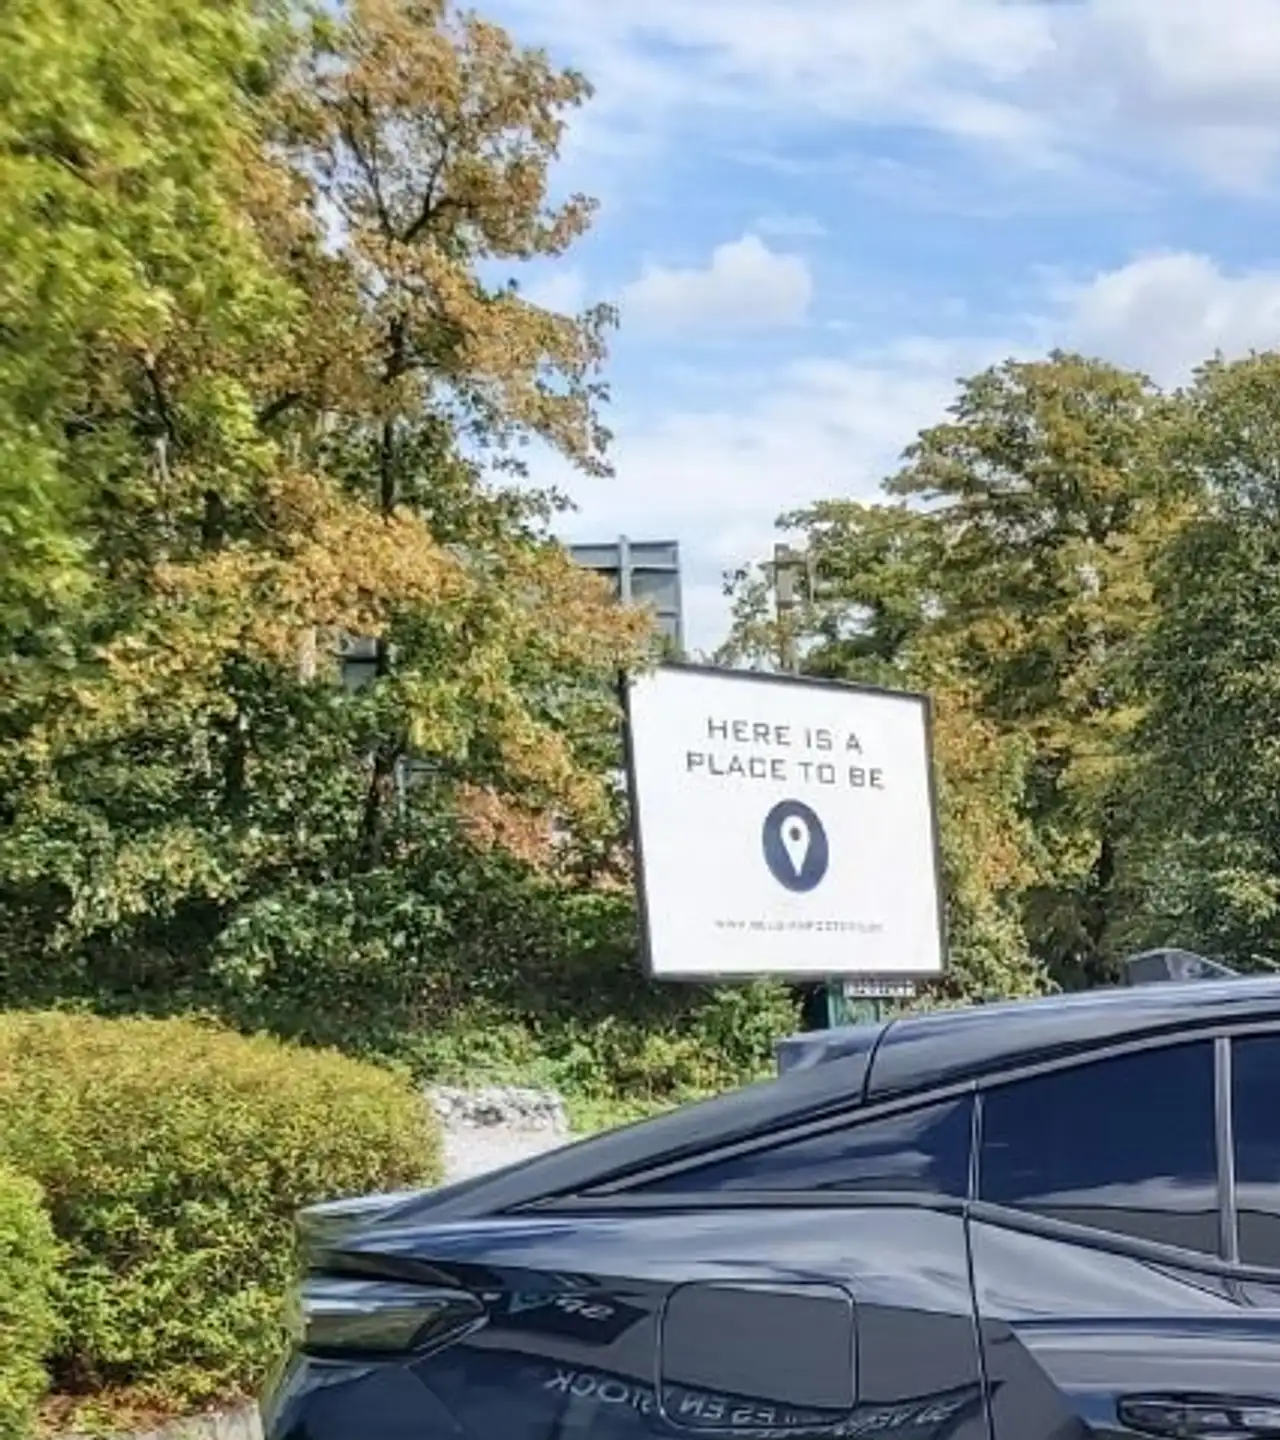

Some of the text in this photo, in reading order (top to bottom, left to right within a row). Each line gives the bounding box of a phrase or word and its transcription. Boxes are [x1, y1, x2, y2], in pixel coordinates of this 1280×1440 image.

[707, 716, 863, 755] HERE IS A
[686, 751, 886, 791] PLACE TO BE
